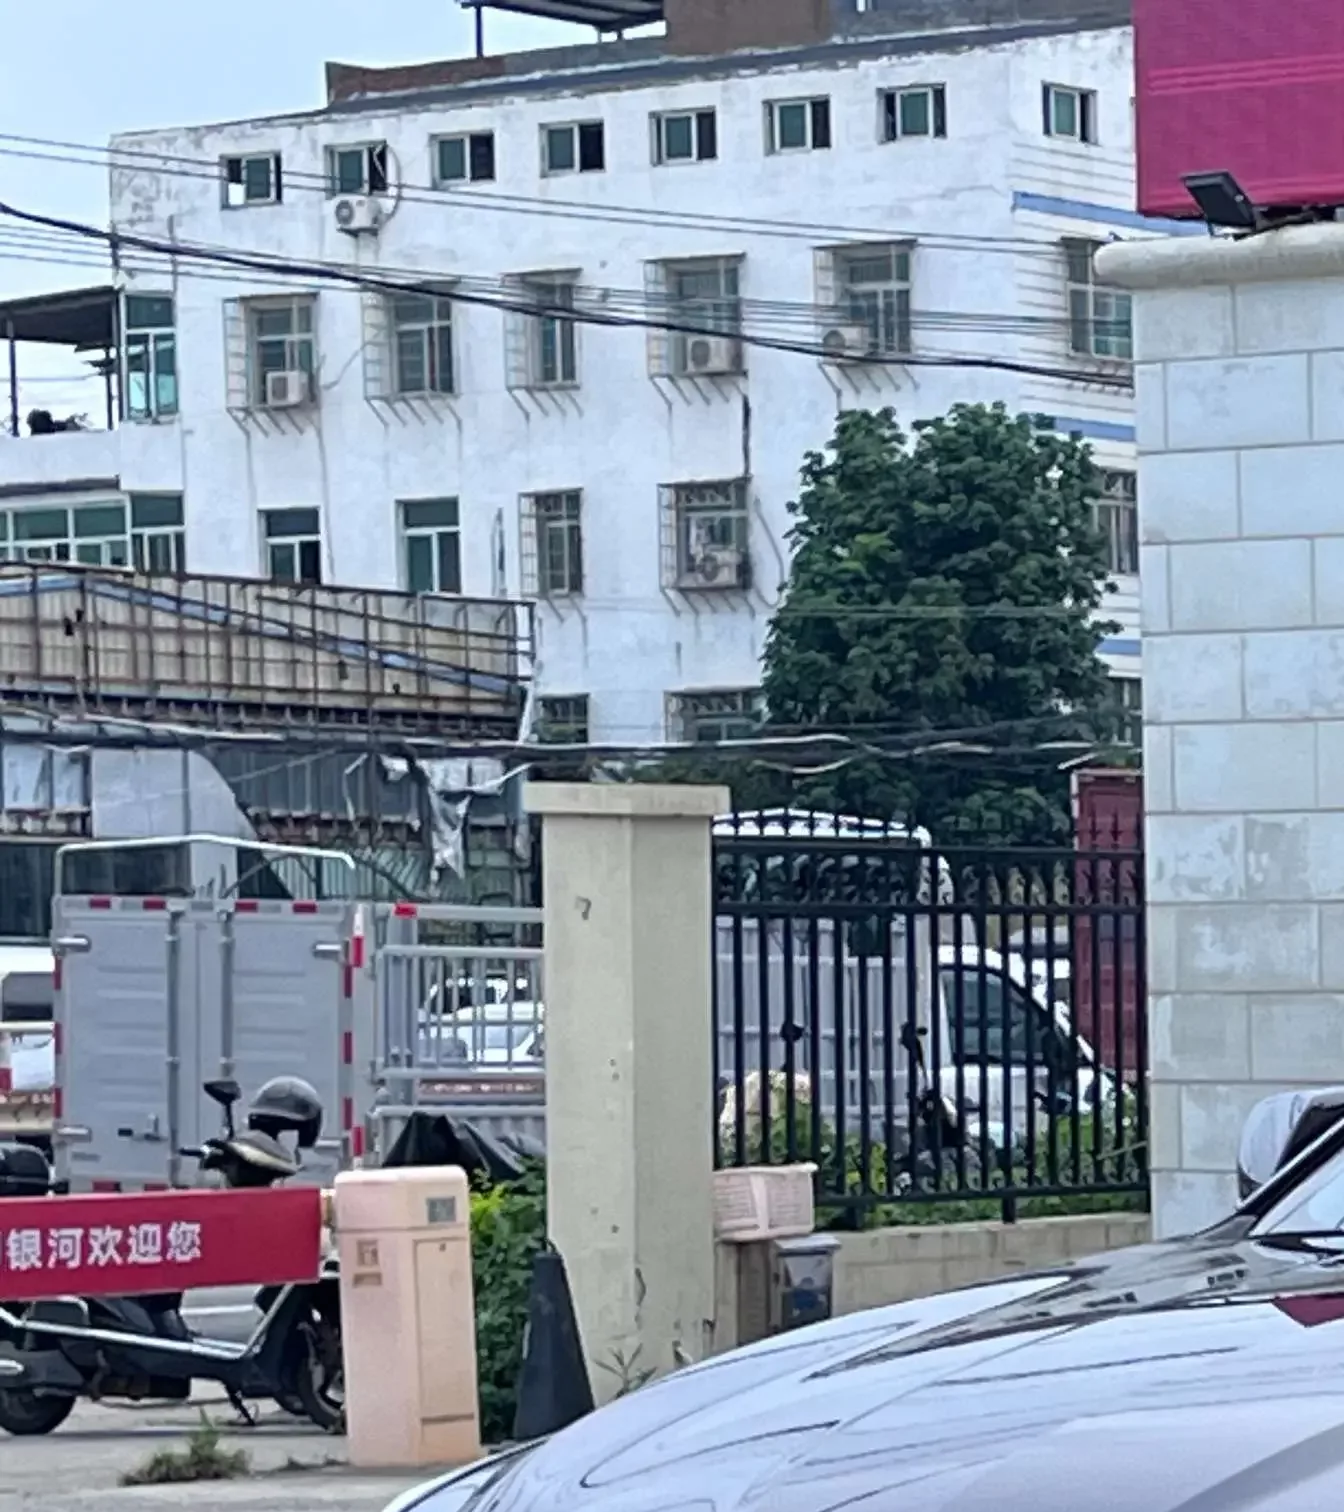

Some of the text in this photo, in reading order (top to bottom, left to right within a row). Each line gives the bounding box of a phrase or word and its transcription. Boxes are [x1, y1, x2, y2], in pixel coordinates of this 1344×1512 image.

[0, 1220, 202, 1271] 银河欢迎您
